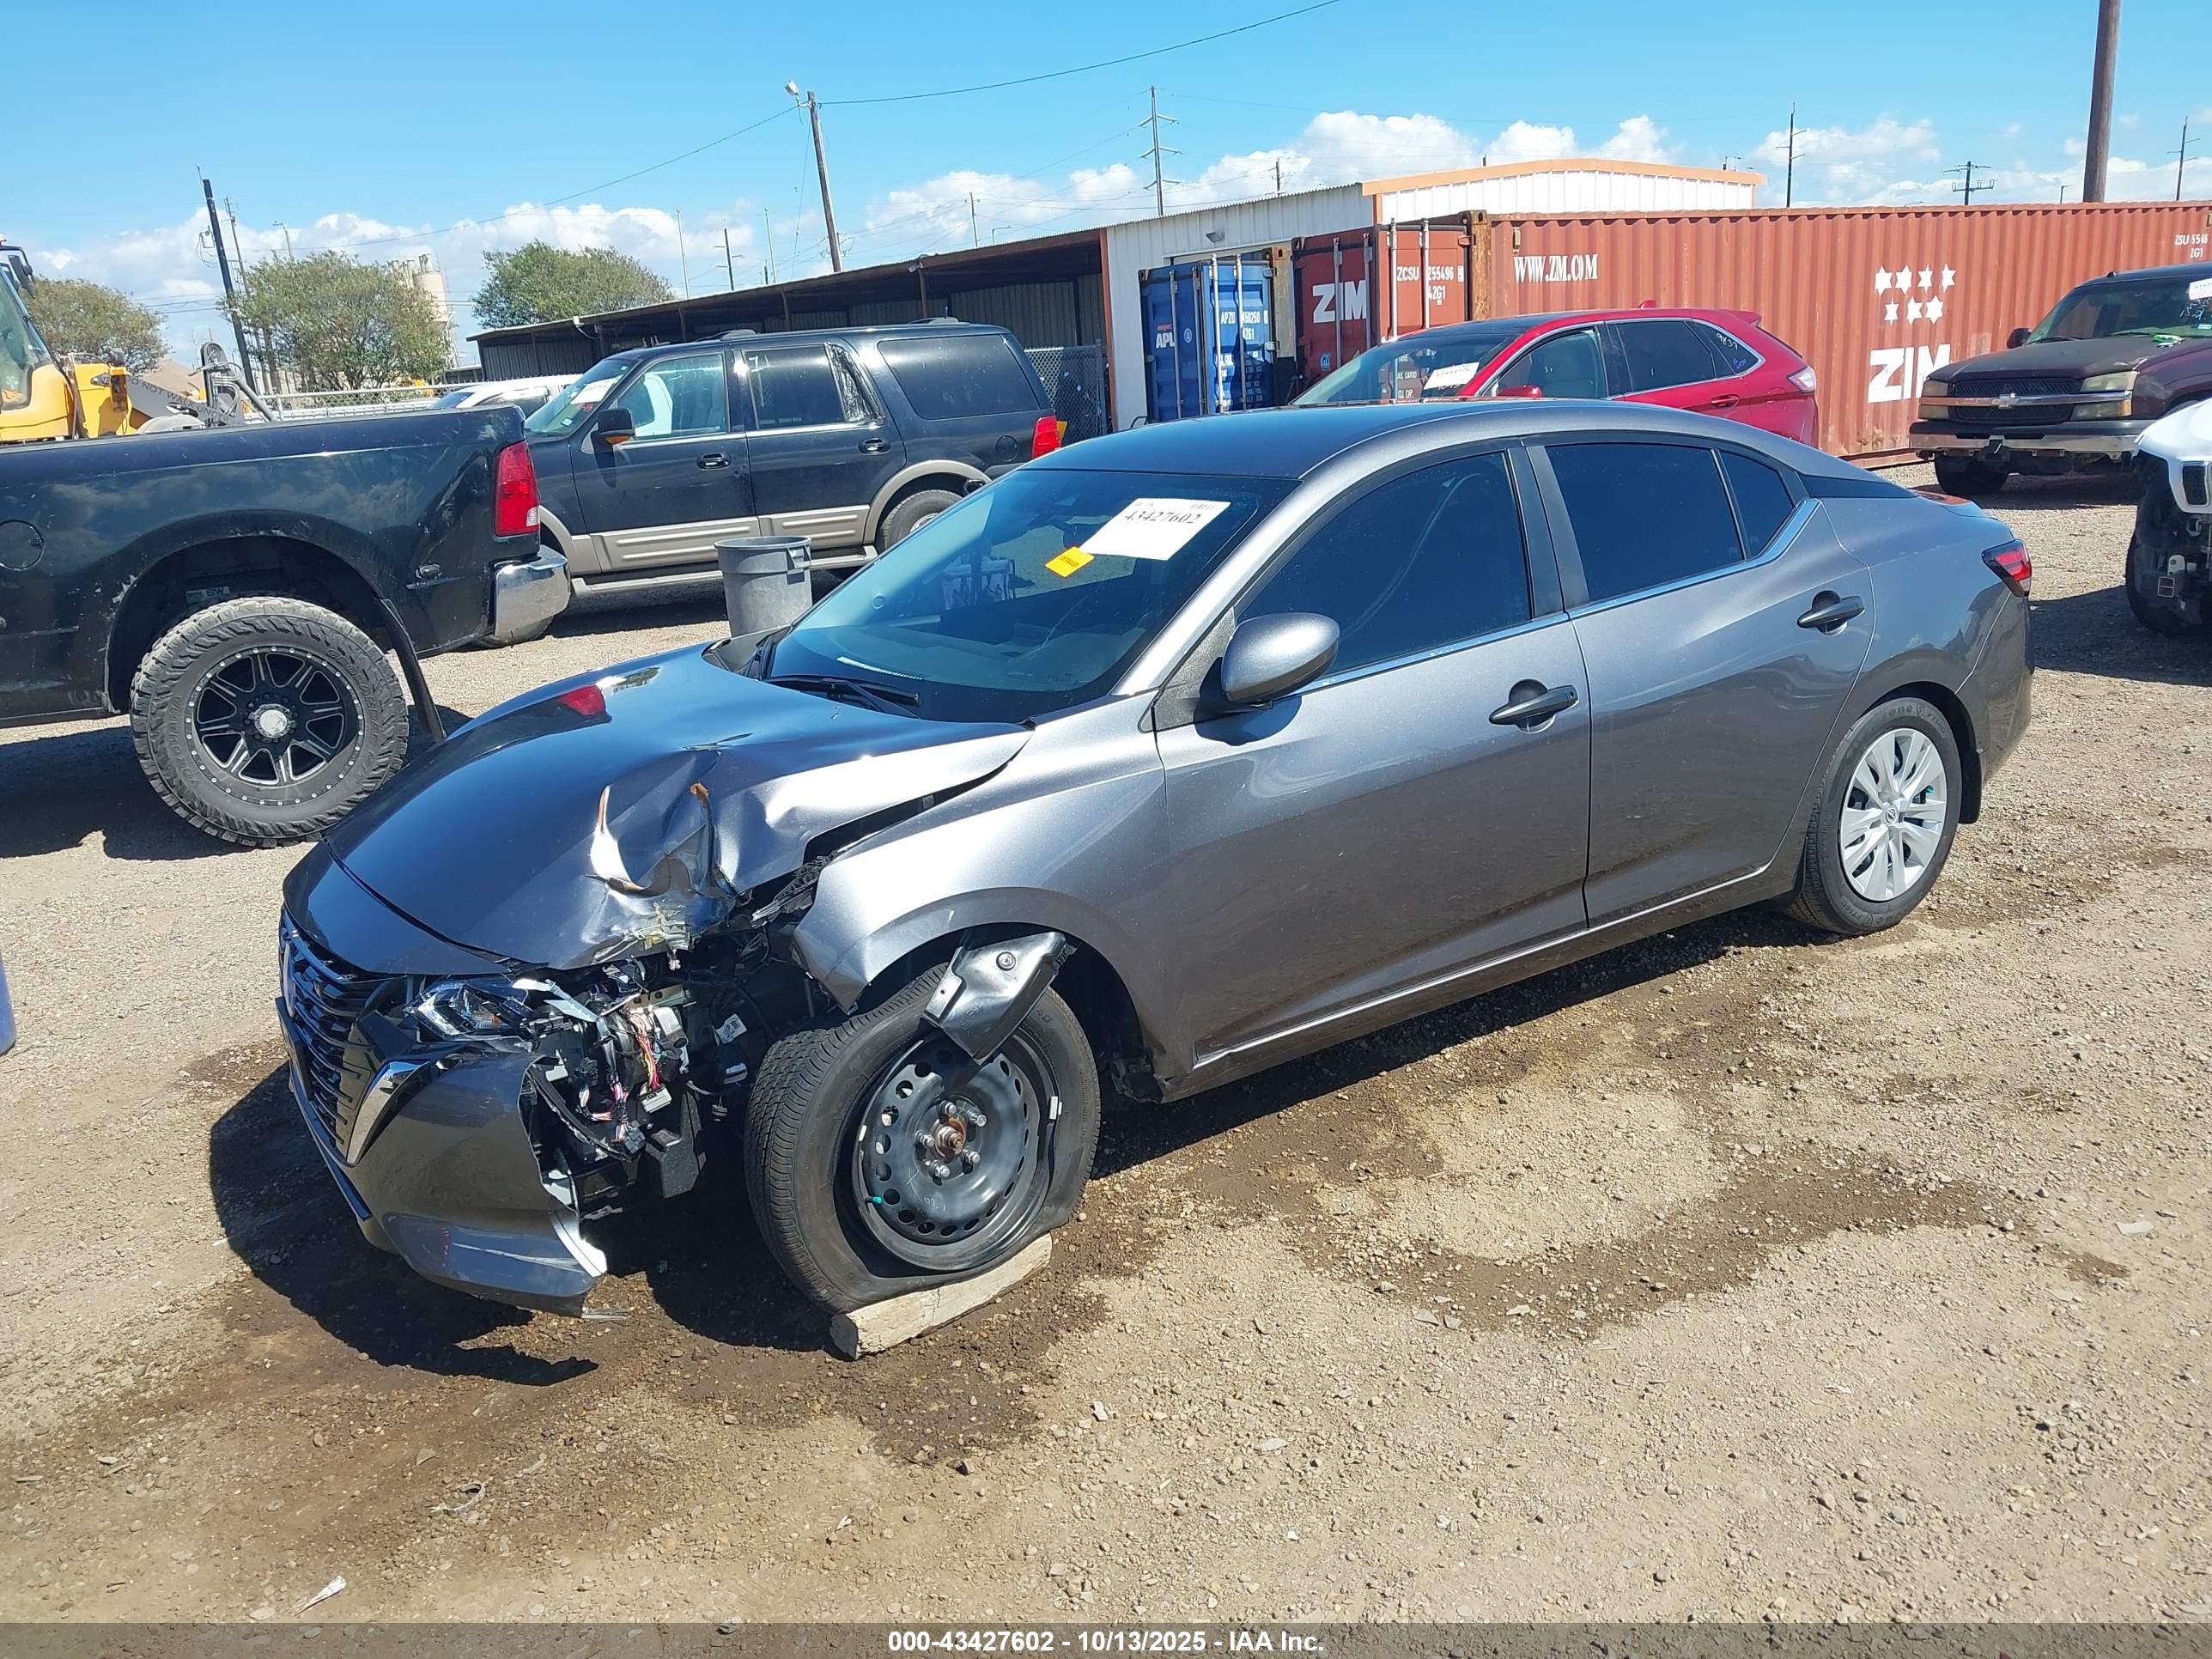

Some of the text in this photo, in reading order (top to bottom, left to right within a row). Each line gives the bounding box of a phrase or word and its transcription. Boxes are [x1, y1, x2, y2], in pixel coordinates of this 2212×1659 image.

[1396, 266, 1419, 281] ZCSU
[1427, 265, 1454, 281] 255496
[1155, 331, 1176, 349] APL
[1868, 343, 1951, 404] ZIM
[141, 381, 162, 396] NOT
[1125, 510, 1201, 524] 43427602
